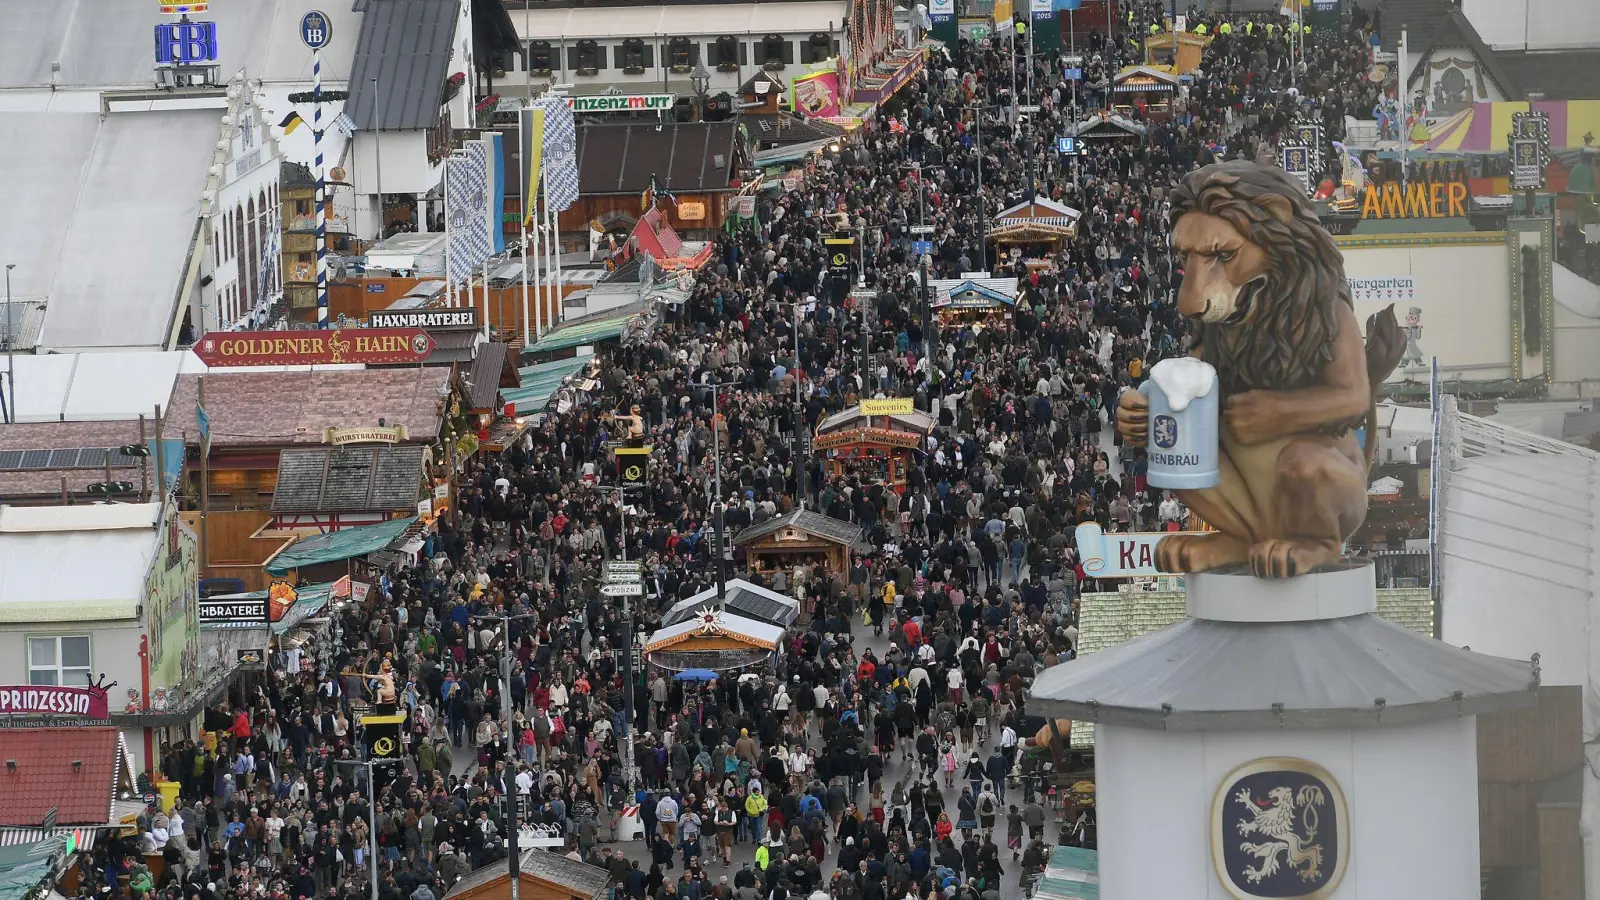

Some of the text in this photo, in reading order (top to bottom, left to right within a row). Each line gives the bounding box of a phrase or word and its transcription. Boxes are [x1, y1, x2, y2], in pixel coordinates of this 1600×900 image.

[1318, 3, 1333, 11] 2025
[1036, 12, 1052, 20] 2025
[307, 29, 323, 43] HB
[158, 24, 208, 63] HB
[1062, 139, 1071, 150] U
[1361, 181, 1467, 219] AMMER
[372, 312, 474, 327] HAXNBRATEREI
[220, 336, 410, 356] GOLDENER HAHN
[865, 403, 908, 412] Souvenirs
[335, 433, 396, 443] WURSTBRATEREI
[816, 435, 911, 447] Souvenirs Andenken
[1119, 541, 1152, 569] KA
[1, 690, 90, 714] PRINZESSIN
